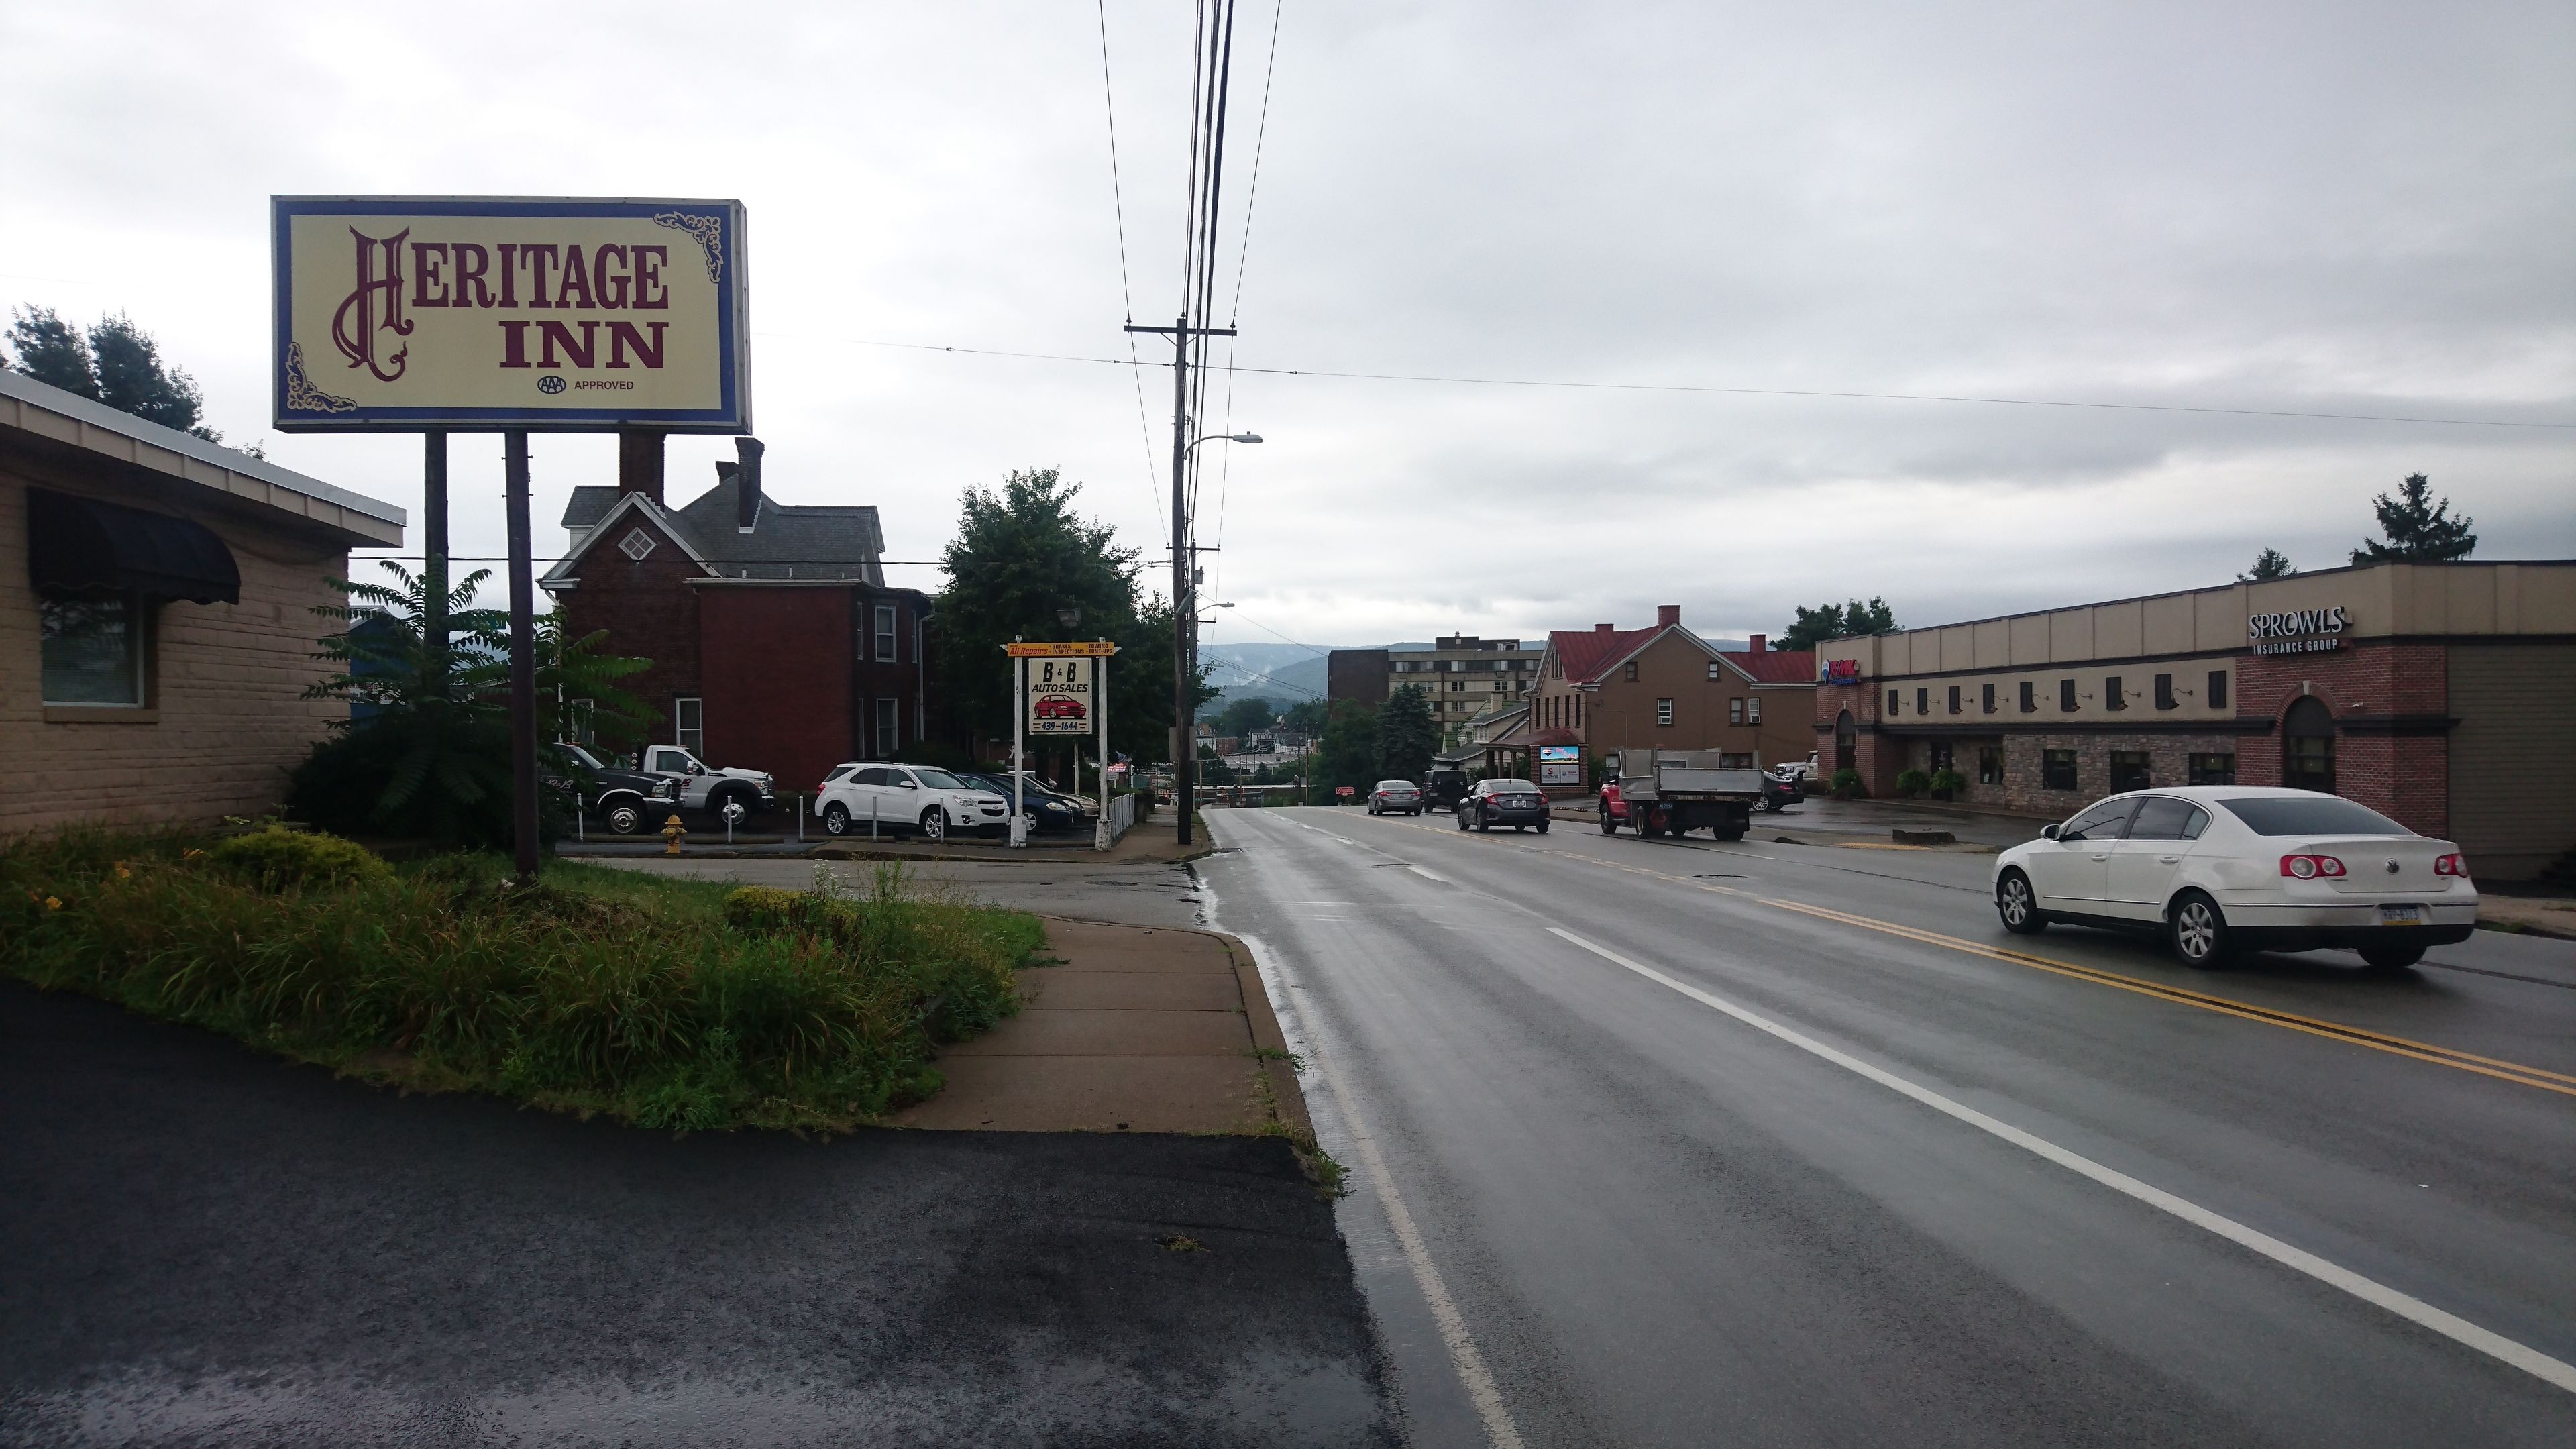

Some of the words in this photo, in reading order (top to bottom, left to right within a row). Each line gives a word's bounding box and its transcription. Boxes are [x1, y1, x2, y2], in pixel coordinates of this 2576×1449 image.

[332, 224, 669, 382] HERITAGE
[499, 321, 669, 368] INN
[539, 376, 566, 394] AAA
[574, 381, 634, 390] APPROVED
[2249, 606, 2345, 639] SPROWLS
[1020, 647, 1049, 656] Repairs
[2253, 641, 2303, 655] INSURANCE
[2307, 639, 2337, 651] GROUP
[1043, 662, 1053, 682] B
[1067, 662, 1077, 682] B
[1042, 722, 1078, 730] 439-1644
